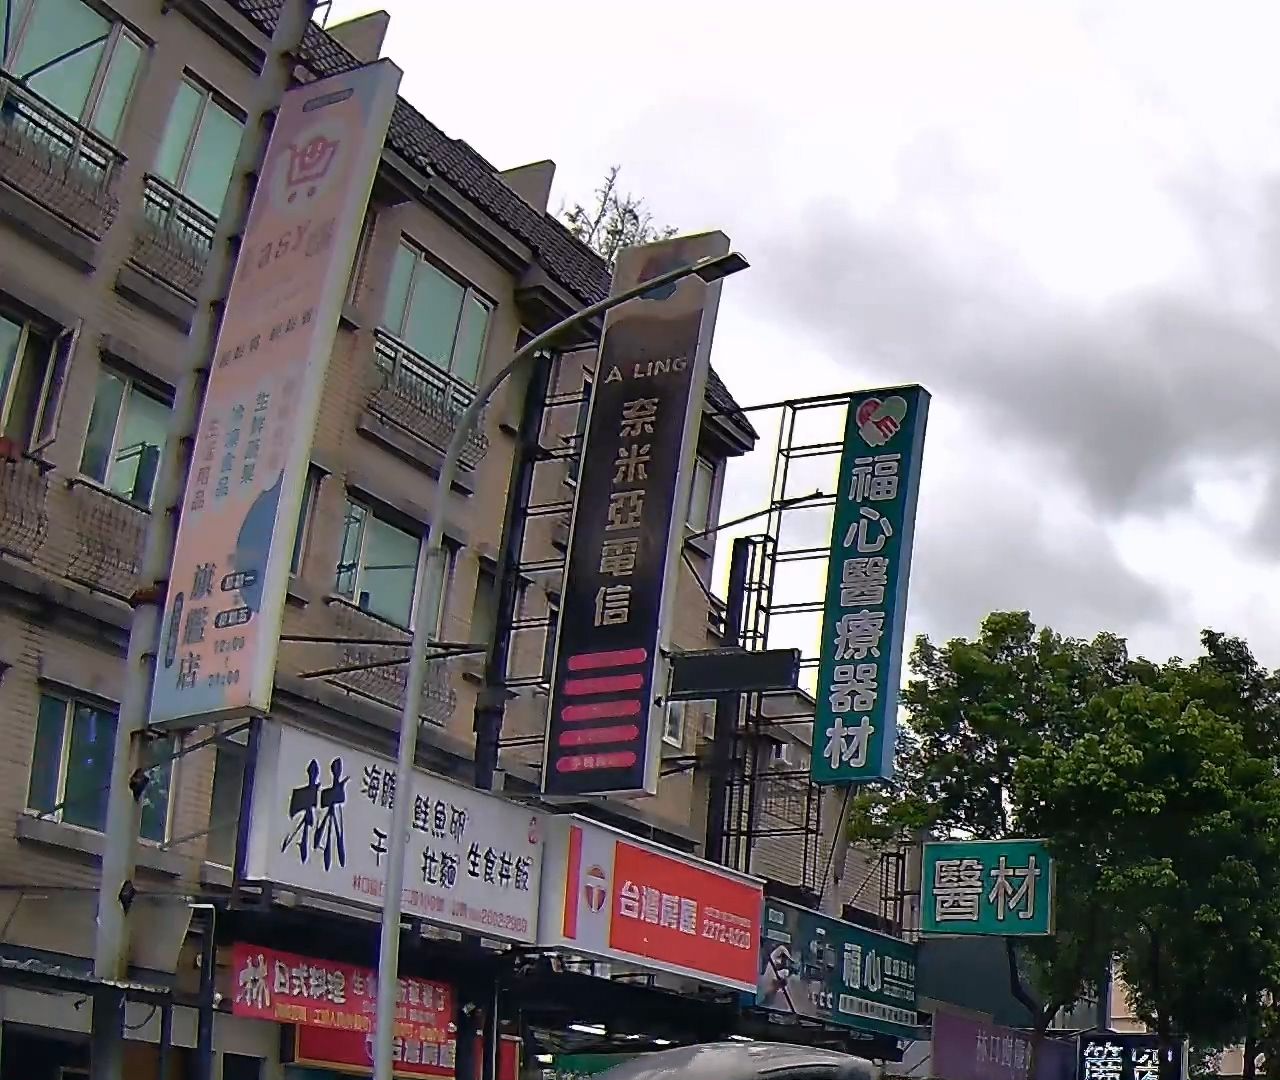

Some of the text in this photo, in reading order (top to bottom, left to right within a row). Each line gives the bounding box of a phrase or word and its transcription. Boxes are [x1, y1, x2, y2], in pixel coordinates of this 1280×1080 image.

[604, 354, 688, 384] A LING
[595, 398, 657, 627] 奈米亞電信
[822, 454, 902, 770] 福心醫療器材
[281, 757, 350, 872] 林
[932, 856, 1041, 922] 醫材
